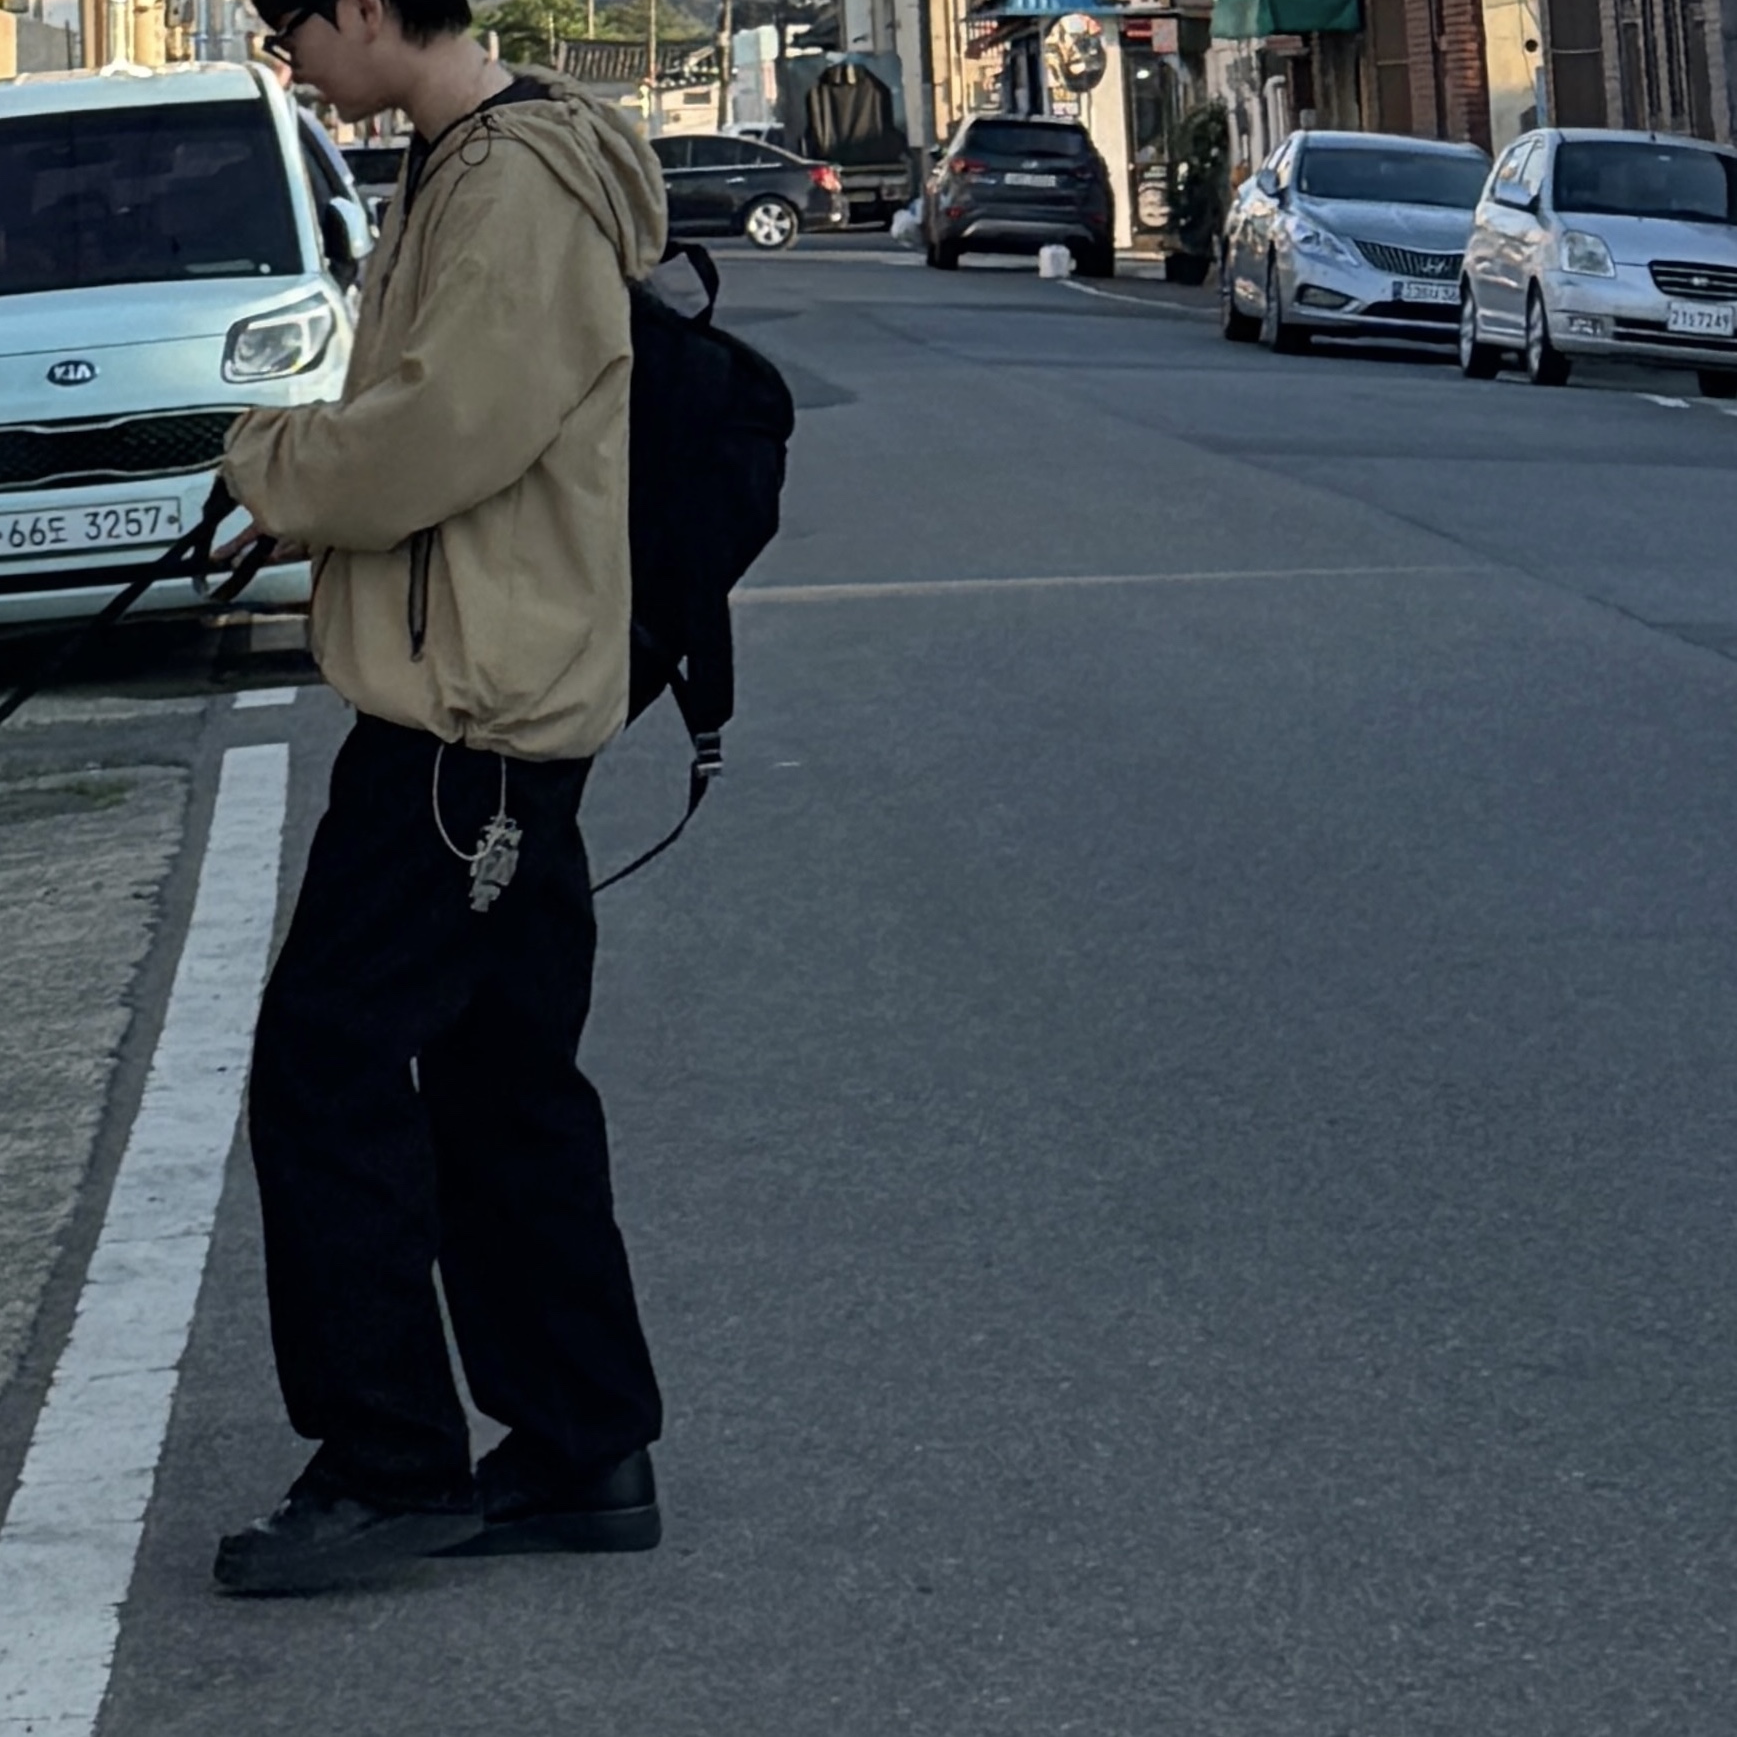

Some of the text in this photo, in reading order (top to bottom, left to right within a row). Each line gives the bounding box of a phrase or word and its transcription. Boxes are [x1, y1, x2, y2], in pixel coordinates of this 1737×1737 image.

[54, 364, 92, 380] KIA
[8, 506, 162, 549] 66도 3257
